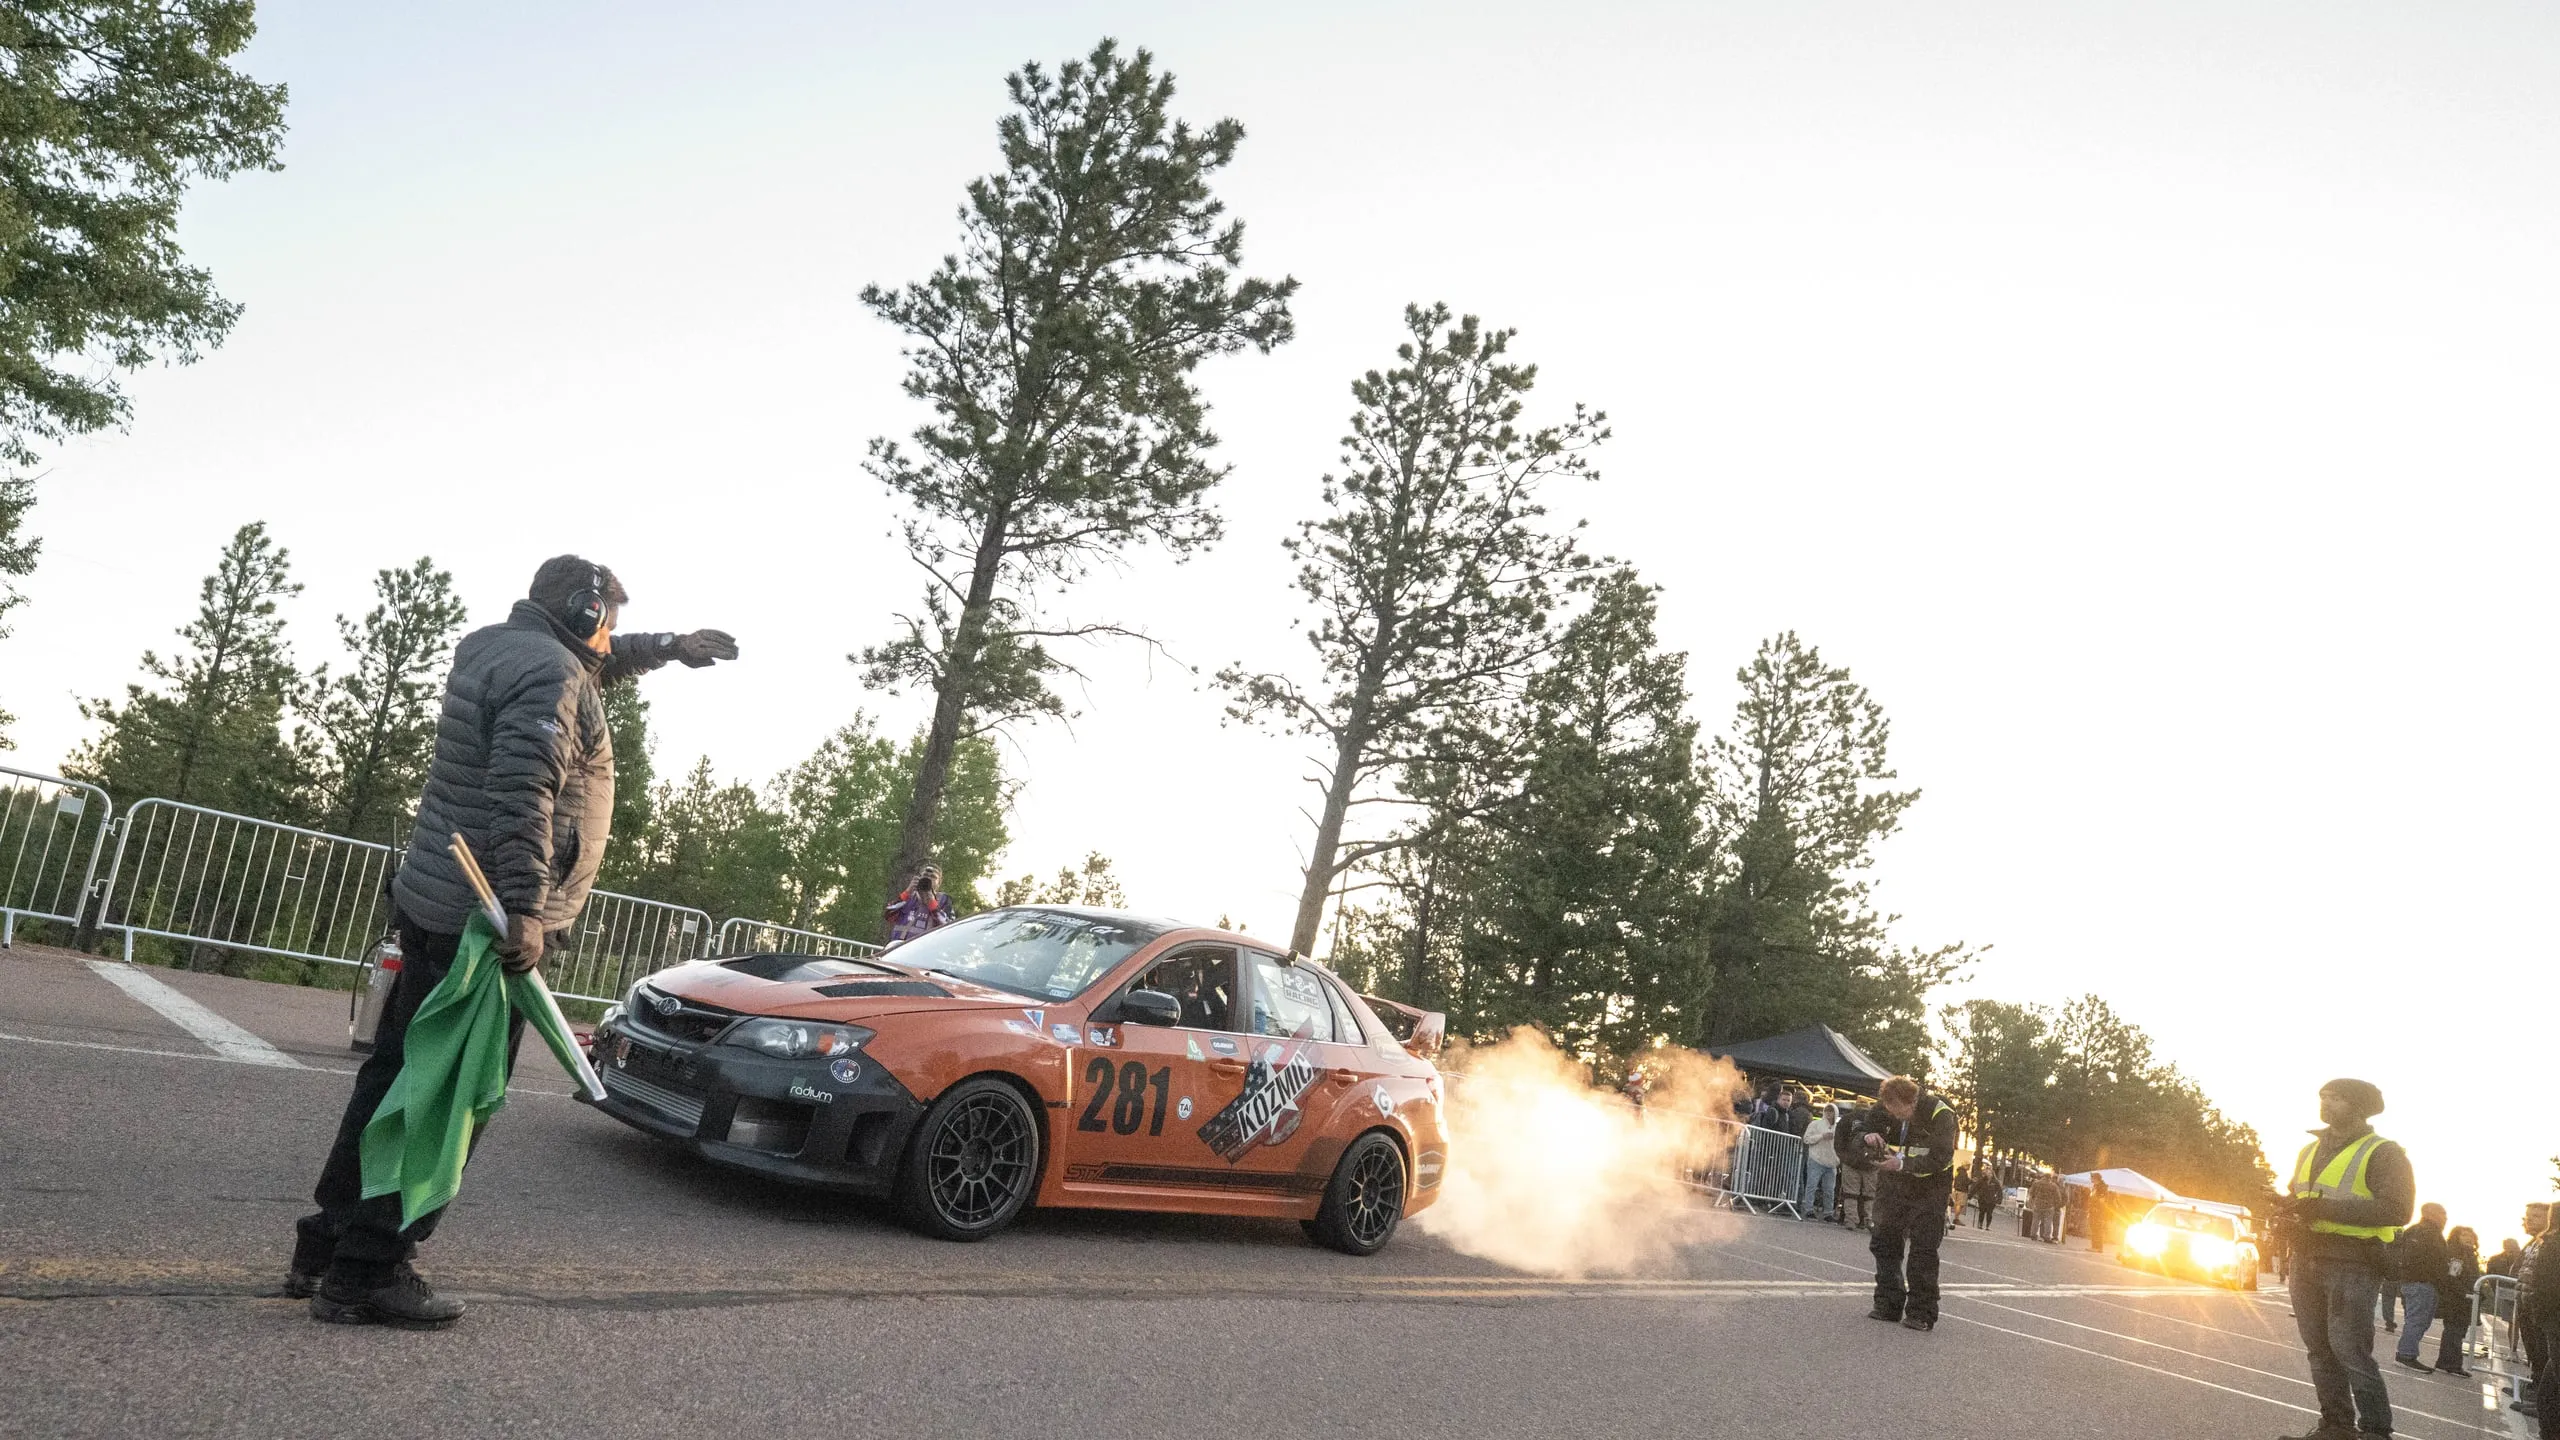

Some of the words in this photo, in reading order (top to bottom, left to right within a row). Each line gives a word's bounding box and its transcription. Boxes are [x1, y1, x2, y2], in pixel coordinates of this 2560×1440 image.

[1286, 988, 1318, 1006] RACING
[790, 1085, 833, 1102] radium
[1077, 1057, 1171, 1136] 281
[1239, 1053, 1311, 1140] KOZMIC
